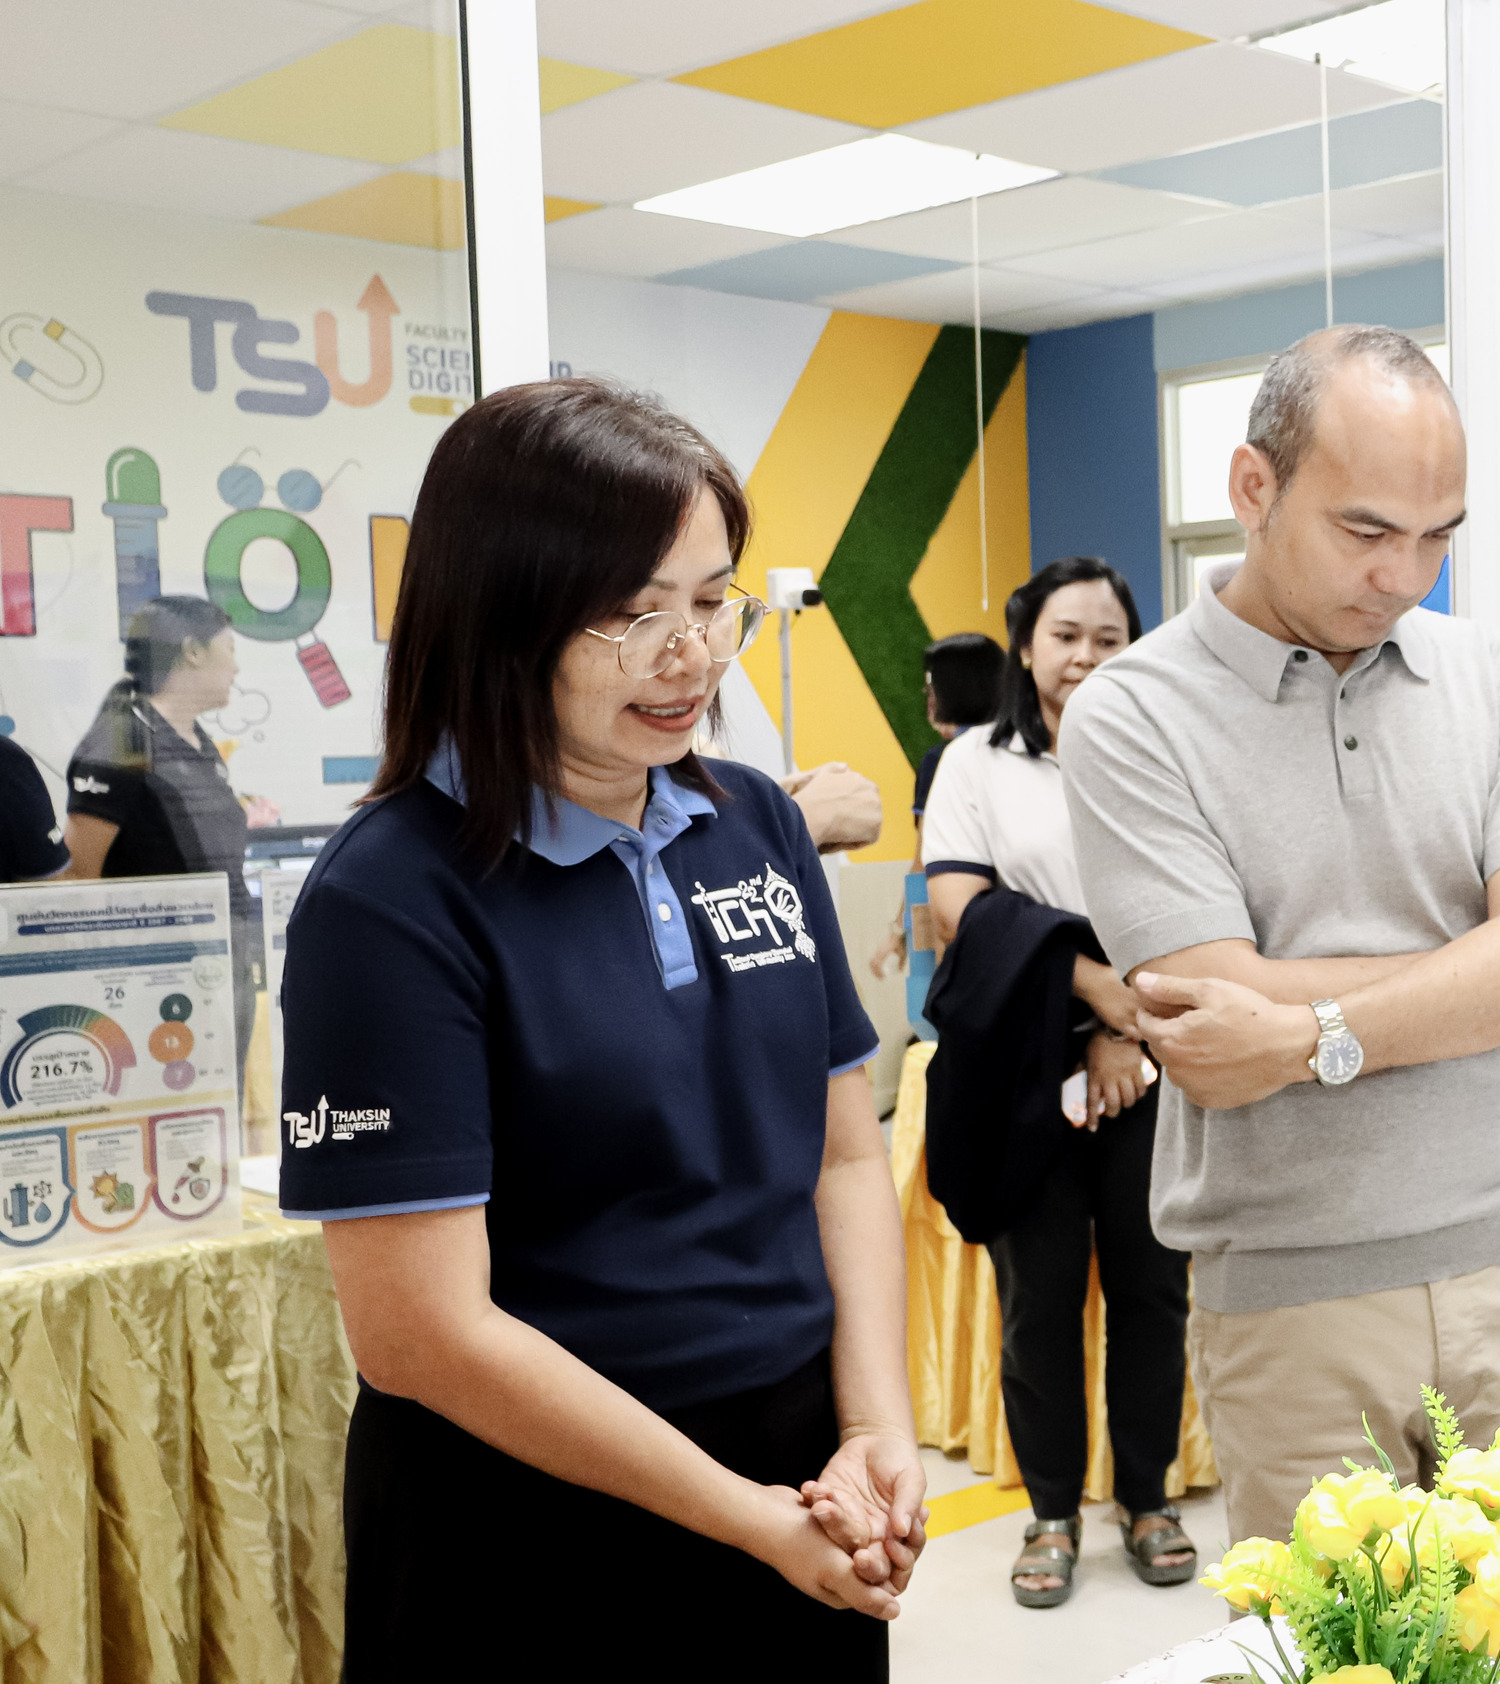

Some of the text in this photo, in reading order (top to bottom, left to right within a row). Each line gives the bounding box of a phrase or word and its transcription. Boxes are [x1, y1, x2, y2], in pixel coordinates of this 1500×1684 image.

[145, 273, 401, 418] TSU
[104, 987, 125, 1001] 26
[30, 1060, 93, 1079] 216.7%
[283, 1094, 330, 1149] TSU
[330, 1108, 391, 1123] THAKSIN
[333, 1121, 390, 1132] UNIVERSITY
